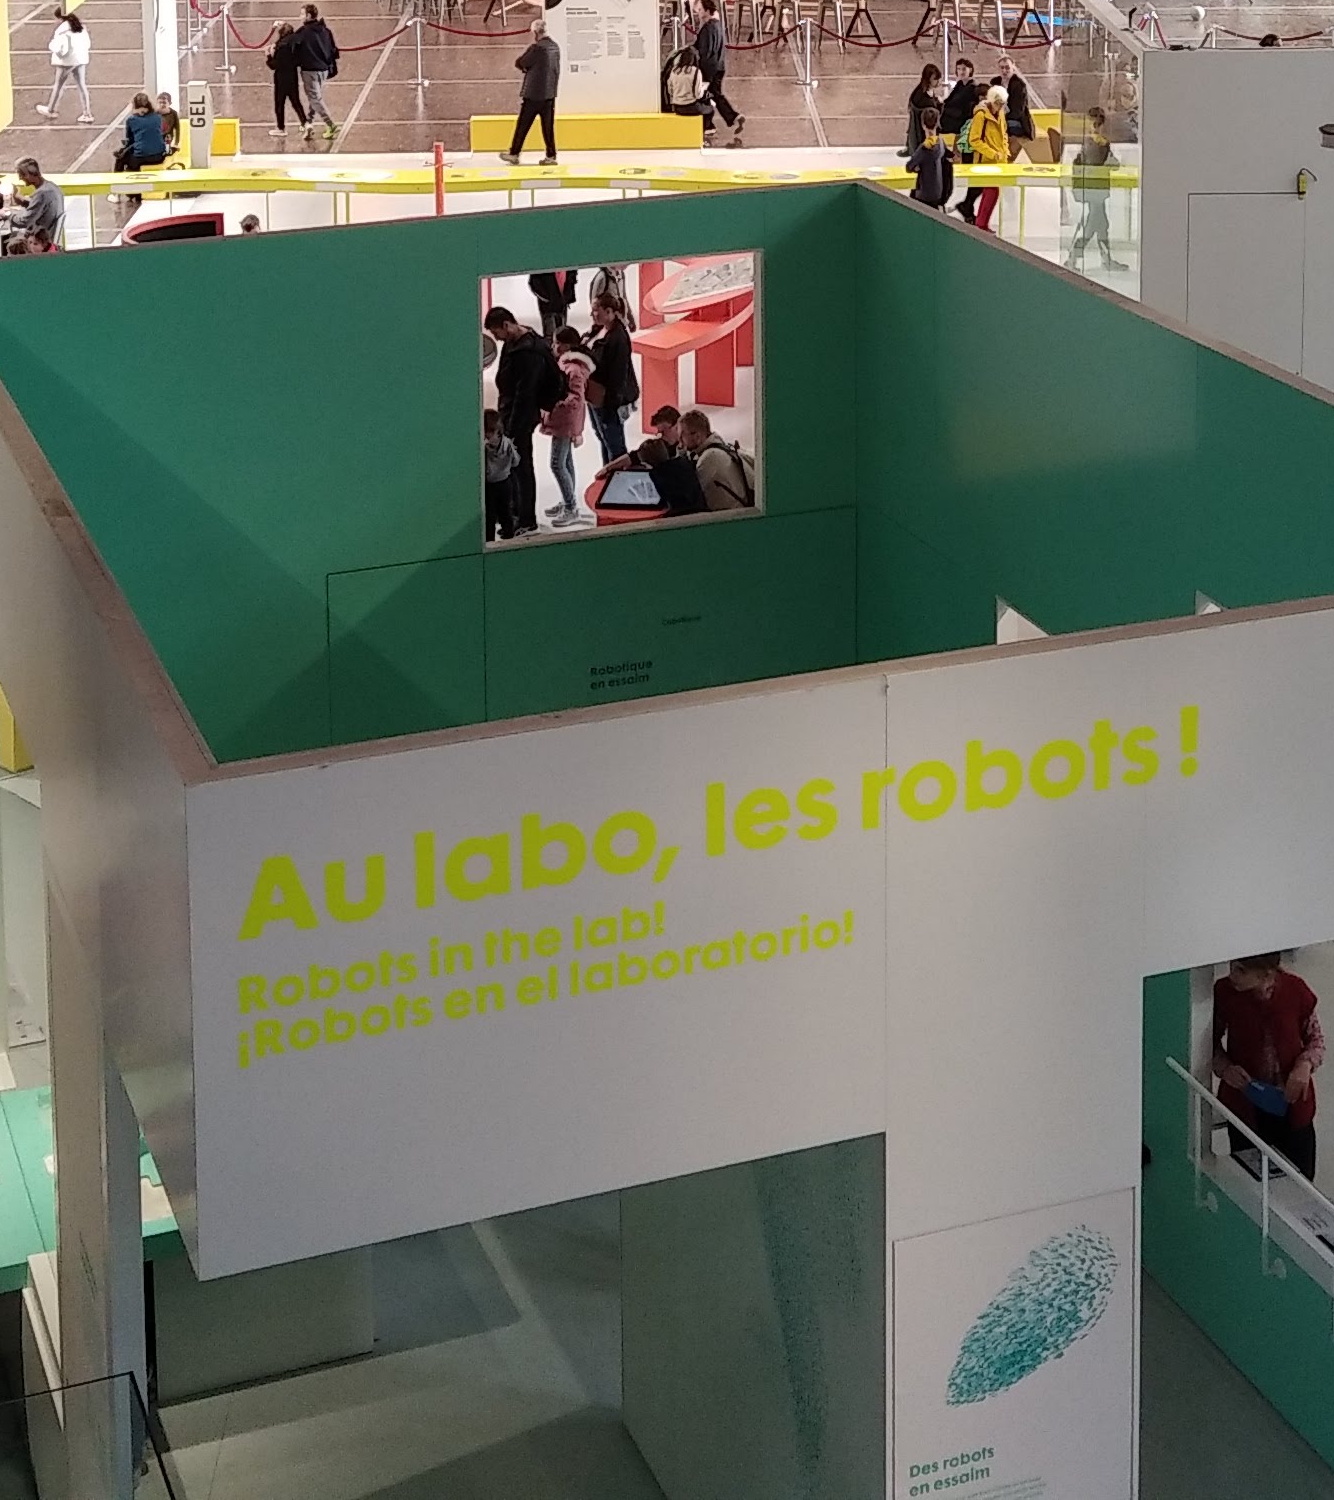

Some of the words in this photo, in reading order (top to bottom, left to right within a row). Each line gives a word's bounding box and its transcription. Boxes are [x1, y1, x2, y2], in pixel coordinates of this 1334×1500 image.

[189, 94, 206, 128] GEL
[590, 660, 653, 677] Robotique
[590, 679, 605, 690] en
[608, 673, 650, 688] essaim
[238, 854, 386, 941] Au
[414, 810, 680, 909] labo,
[705, 777, 839, 857] les
[861, 719, 1160, 831] robots
[239, 950, 418, 1015] Robots
[429, 936, 474, 978] in
[484, 926, 563, 968] the
[573, 900, 665, 951] lab!
[238, 993, 433, 1069] ¡Robots
[443, 982, 505, 1020] en
[516, 964, 558, 1005] el
[569, 909, 854, 996] laboratorio!
[909, 1461, 940, 1478] Des
[942, 1446, 995, 1470] robots
[909, 1483, 930, 1498] en
[933, 1466, 991, 1491] essaim
